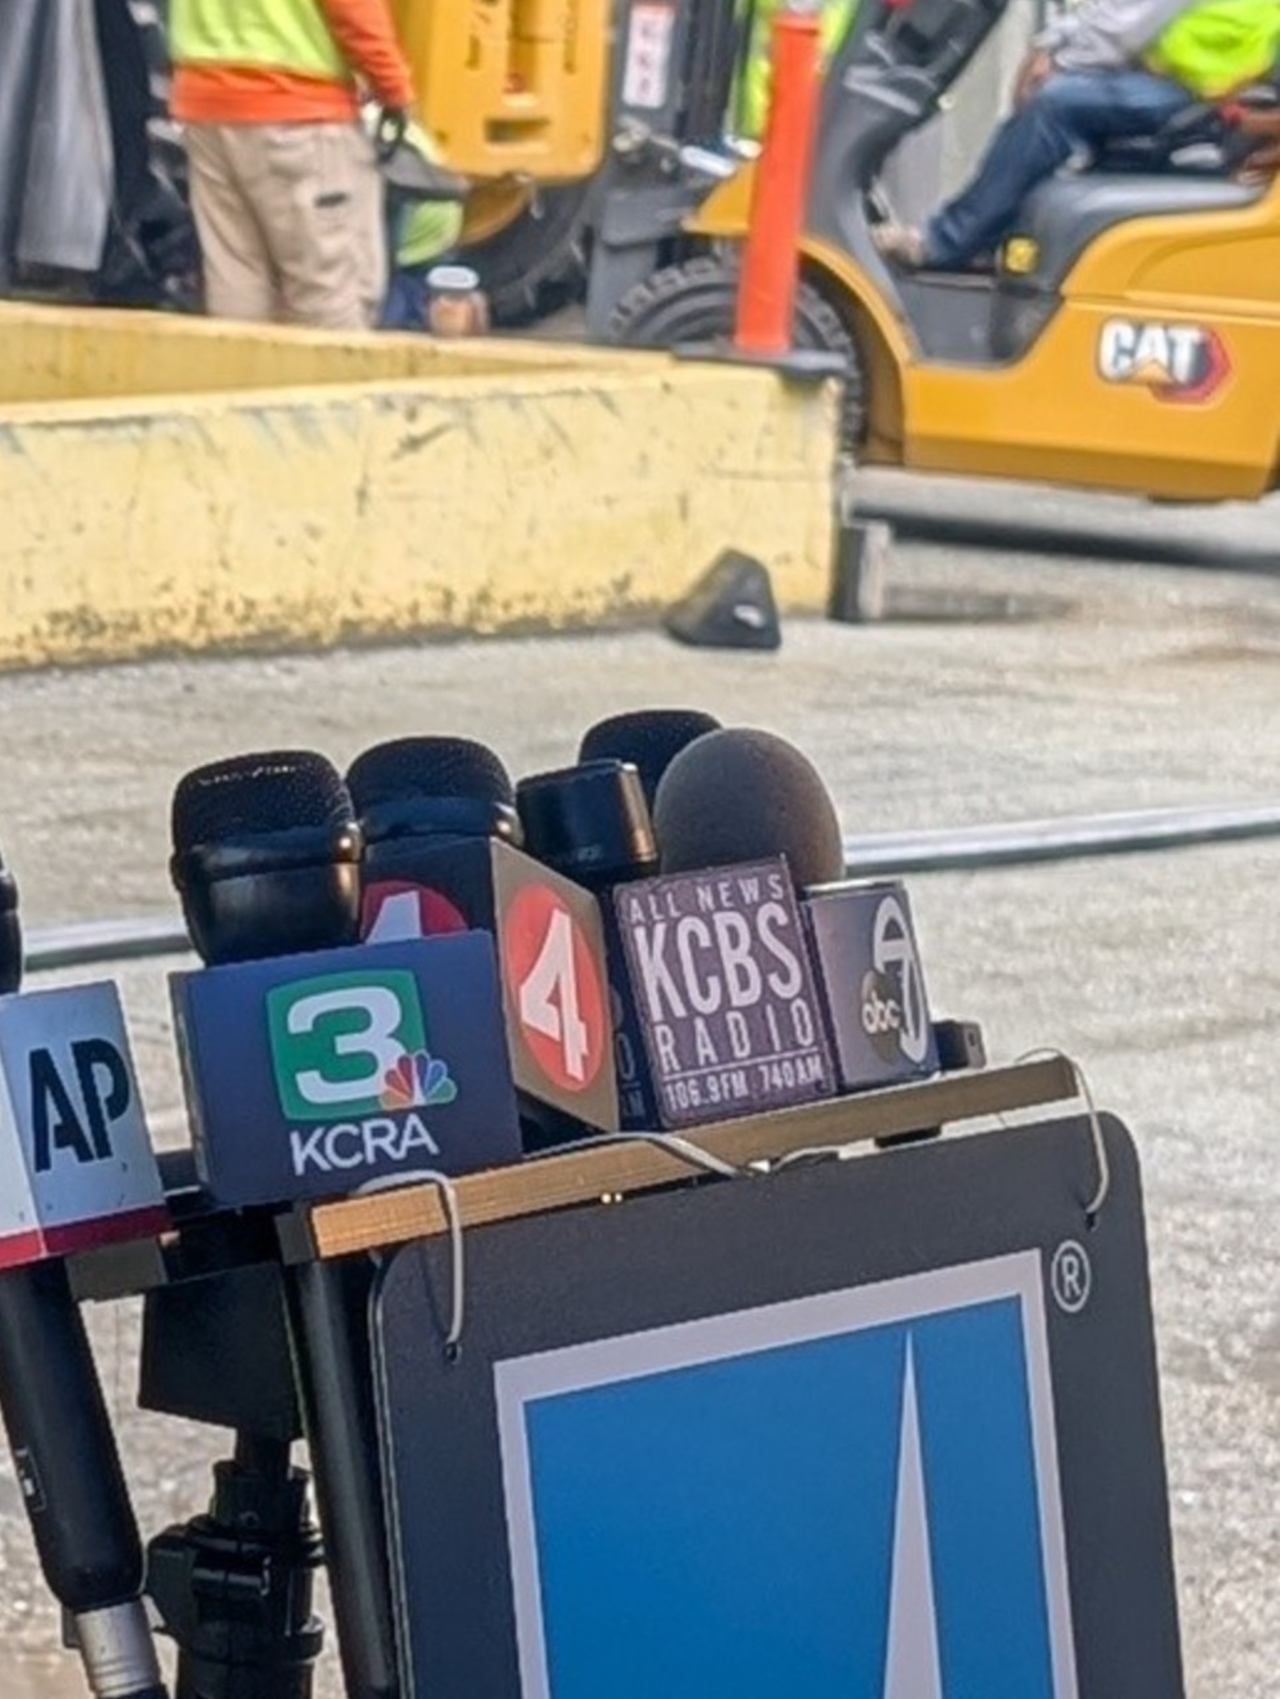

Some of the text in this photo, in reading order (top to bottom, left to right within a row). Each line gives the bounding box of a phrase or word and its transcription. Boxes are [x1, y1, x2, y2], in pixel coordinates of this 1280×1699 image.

[1099, 316, 1203, 384] CAT
[629, 873, 785, 925] ALL NEWS
[519, 906, 591, 1083] 4
[633, 901, 804, 1023] KCBS
[287, 985, 408, 1106] 3
[654, 998, 815, 1075] RADIO
[861, 989, 902, 1036] abc
[28, 1037, 131, 1174] AP
[758, 1053, 826, 1092] 740AM
[289, 1112, 440, 1177] KCRA
